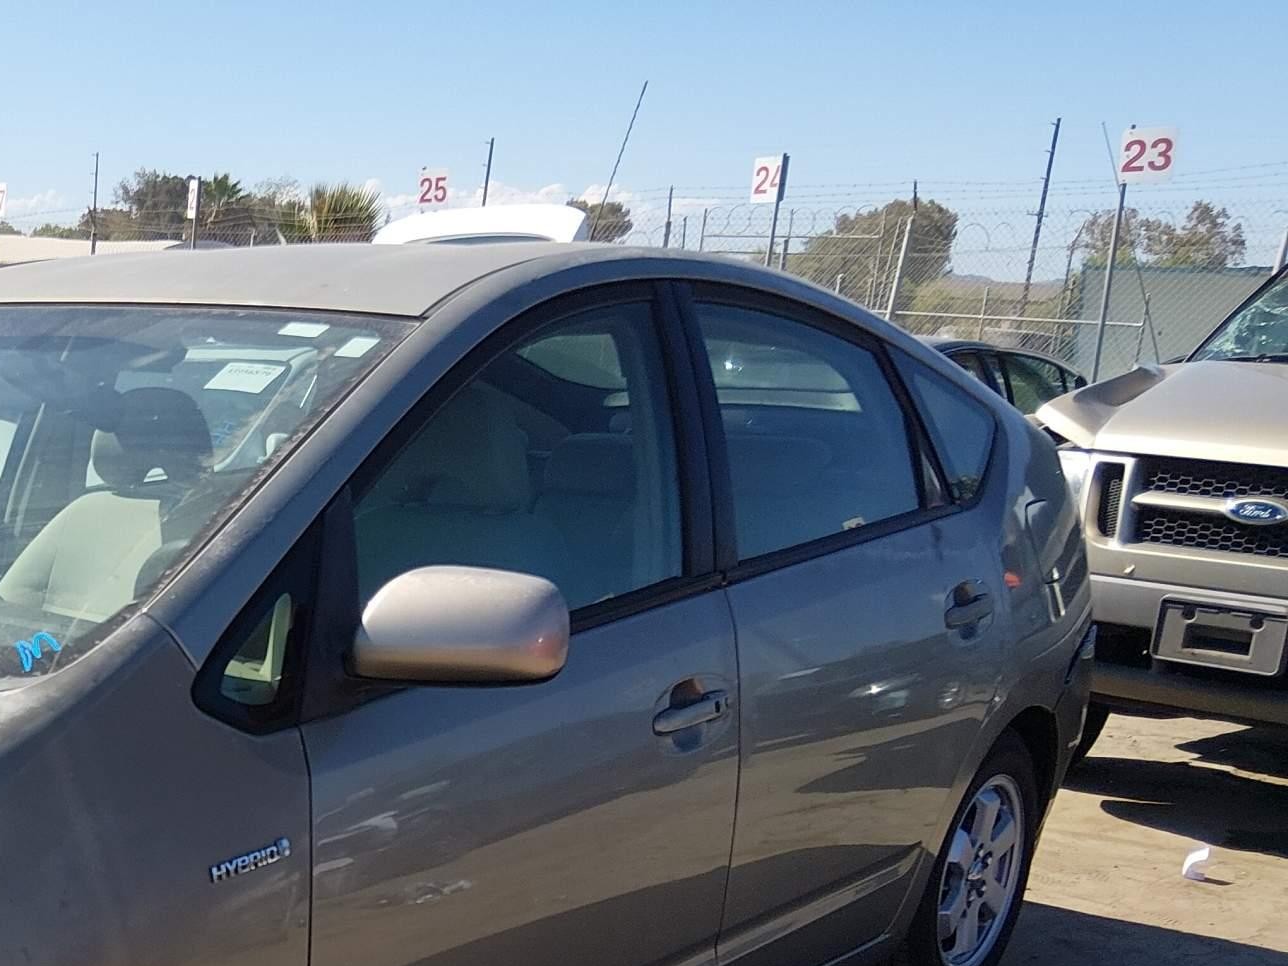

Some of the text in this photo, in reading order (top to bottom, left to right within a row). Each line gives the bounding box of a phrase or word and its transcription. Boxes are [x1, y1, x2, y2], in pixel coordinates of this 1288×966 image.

[1121, 137, 1174, 172] 23
[419, 176, 447, 203] 25
[1239, 504, 1273, 518] Ford
[211, 845, 280, 882] HYBRID
